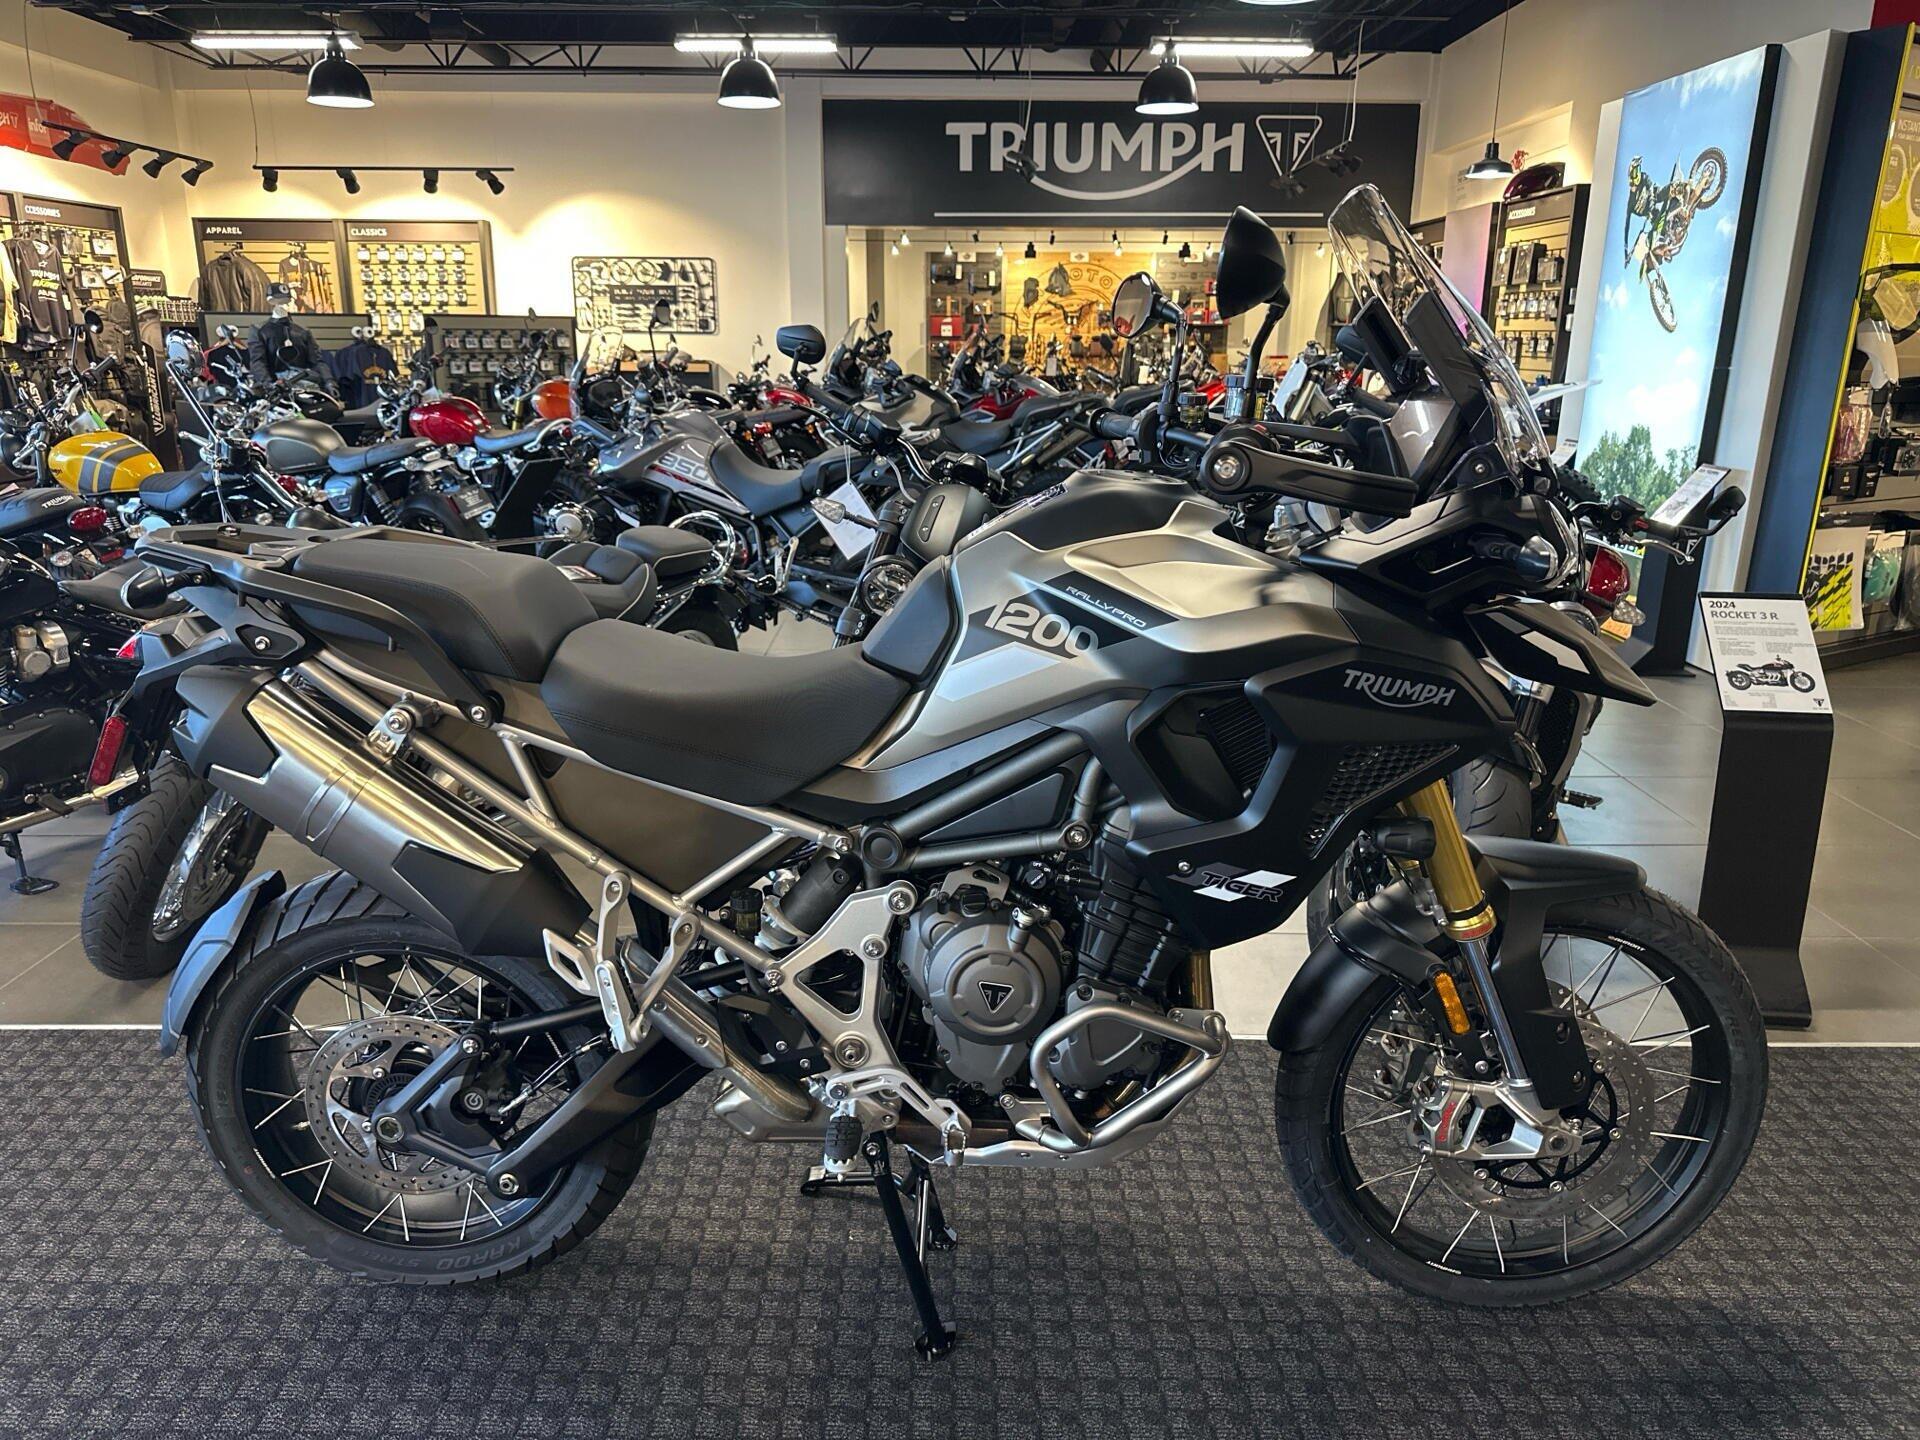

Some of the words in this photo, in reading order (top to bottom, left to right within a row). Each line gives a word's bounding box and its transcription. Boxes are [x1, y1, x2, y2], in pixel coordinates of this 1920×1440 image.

[946, 122, 1245, 200] TRIUMPH
[206, 226, 242, 235] APPAREL
[350, 228, 387, 237] CLASSICS
[41, 495, 74, 508] TRIUMPH
[1709, 600, 1736, 609] 2024
[1711, 610, 1757, 620] ROCKET
[1760, 611, 1767, 620] 3
[1770, 612, 1779, 620] R
[984, 600, 1099, 657] 1200
[1343, 668, 1456, 708] TRIUMPH
[1201, 870, 1284, 903] TIGER
